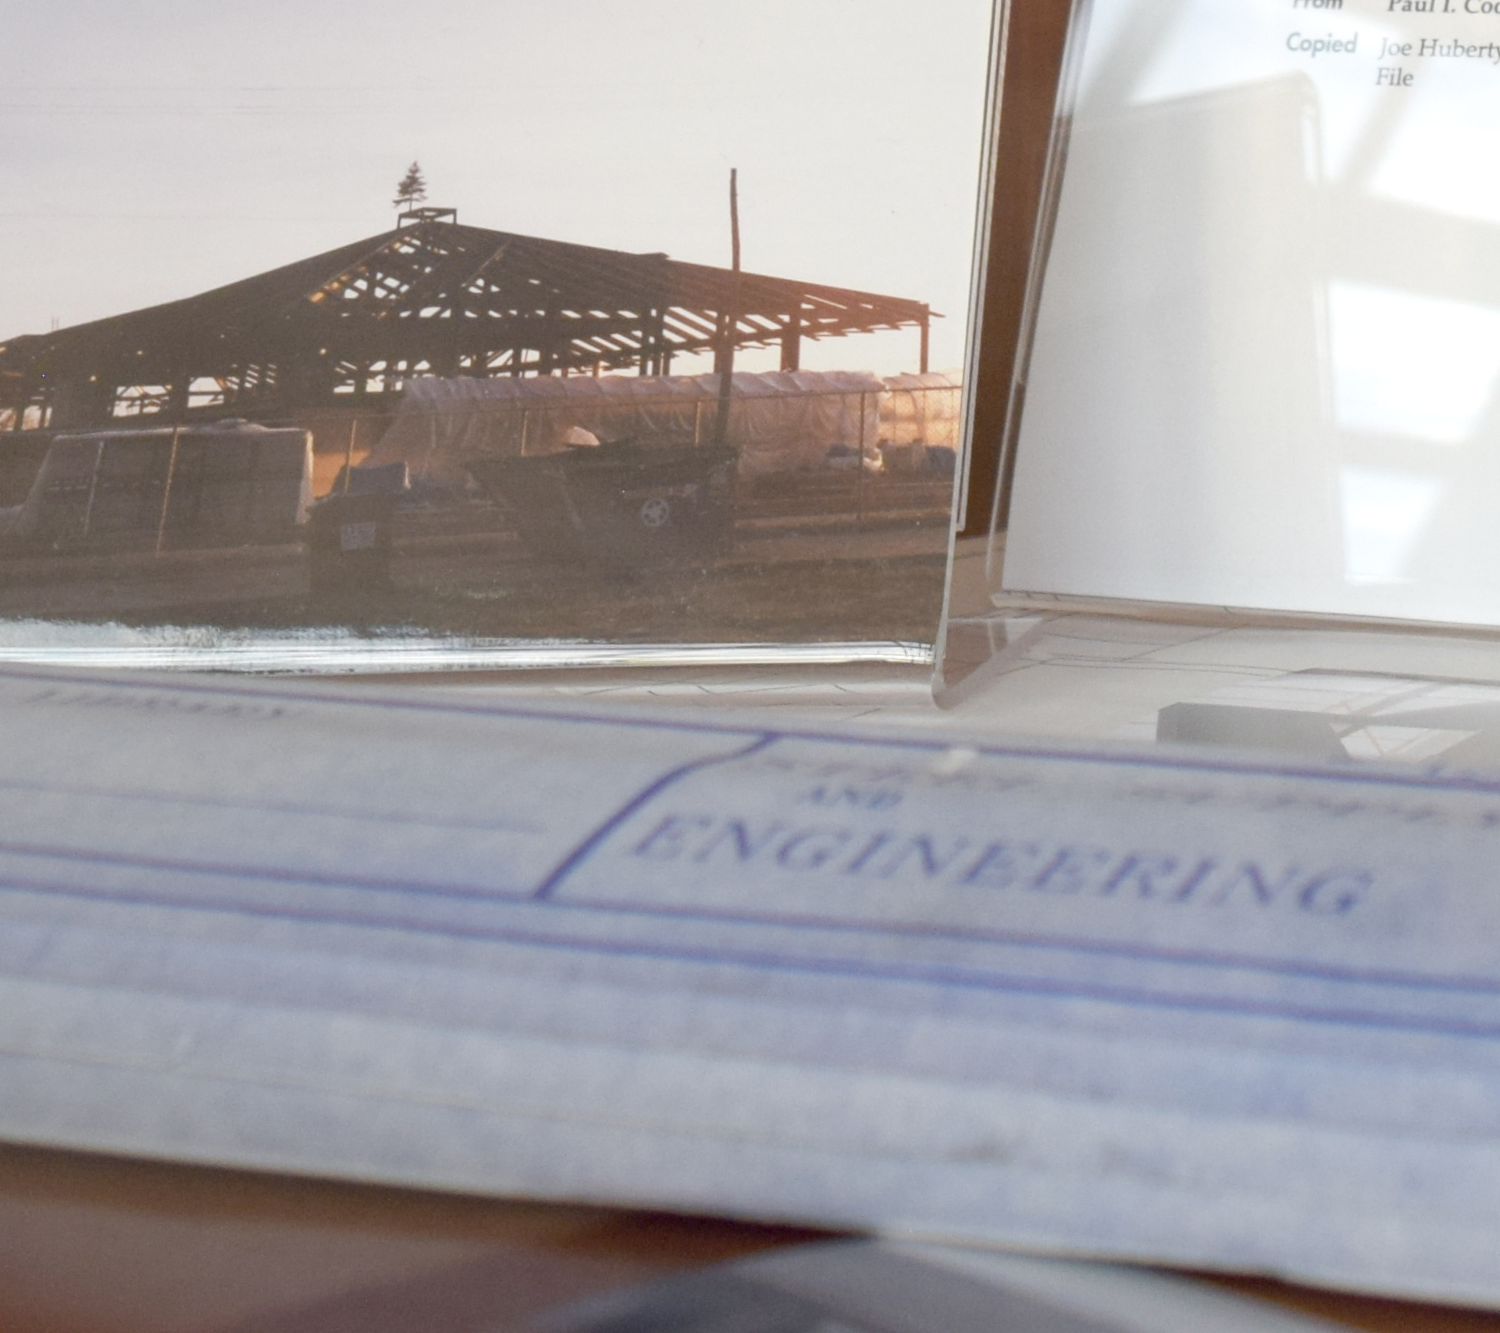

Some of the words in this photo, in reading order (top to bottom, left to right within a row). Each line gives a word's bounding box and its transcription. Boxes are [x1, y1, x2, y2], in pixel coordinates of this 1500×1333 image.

[1285, 32, 1358, 58] Copied
[1377, 36, 1413, 61] Joe
[1375, 67, 1415, 88] File
[801, 783, 906, 811] AND
[626, 812, 1377, 918] ENGINEERING
